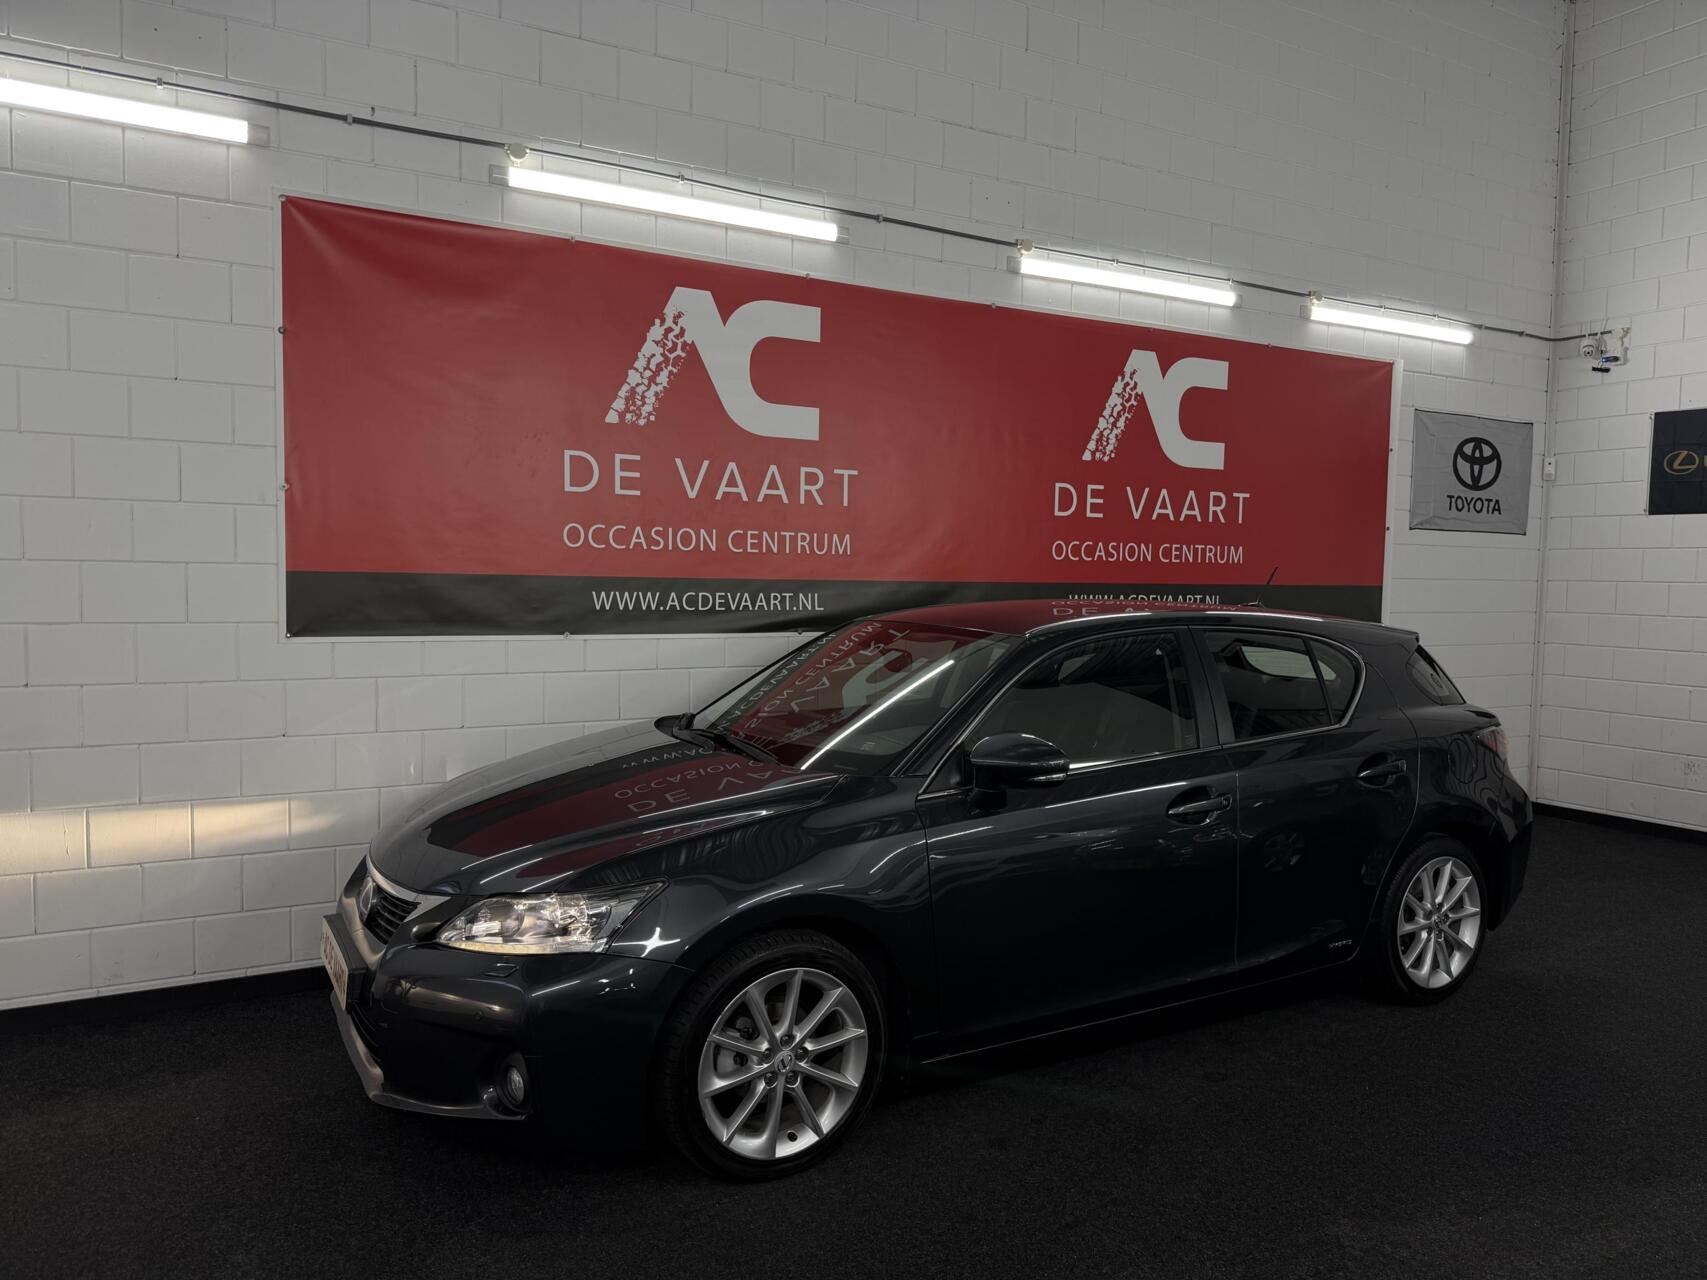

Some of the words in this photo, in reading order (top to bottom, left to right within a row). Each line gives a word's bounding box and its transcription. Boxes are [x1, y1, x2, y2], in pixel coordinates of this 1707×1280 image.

[563, 449, 641, 496] DE
[674, 457, 859, 507] VAART
[1054, 482, 1105, 518] DE
[1126, 486, 1250, 524] VAART
[1446, 494, 1502, 515] TOYOTA
[562, 522, 716, 552] OCCASION
[727, 529, 851, 555] CENTRUM
[1052, 540, 1152, 562] OCCASION
[1159, 543, 1243, 564] CENTRUM
[592, 591, 825, 611] WWW.ACDEVAART.NL
